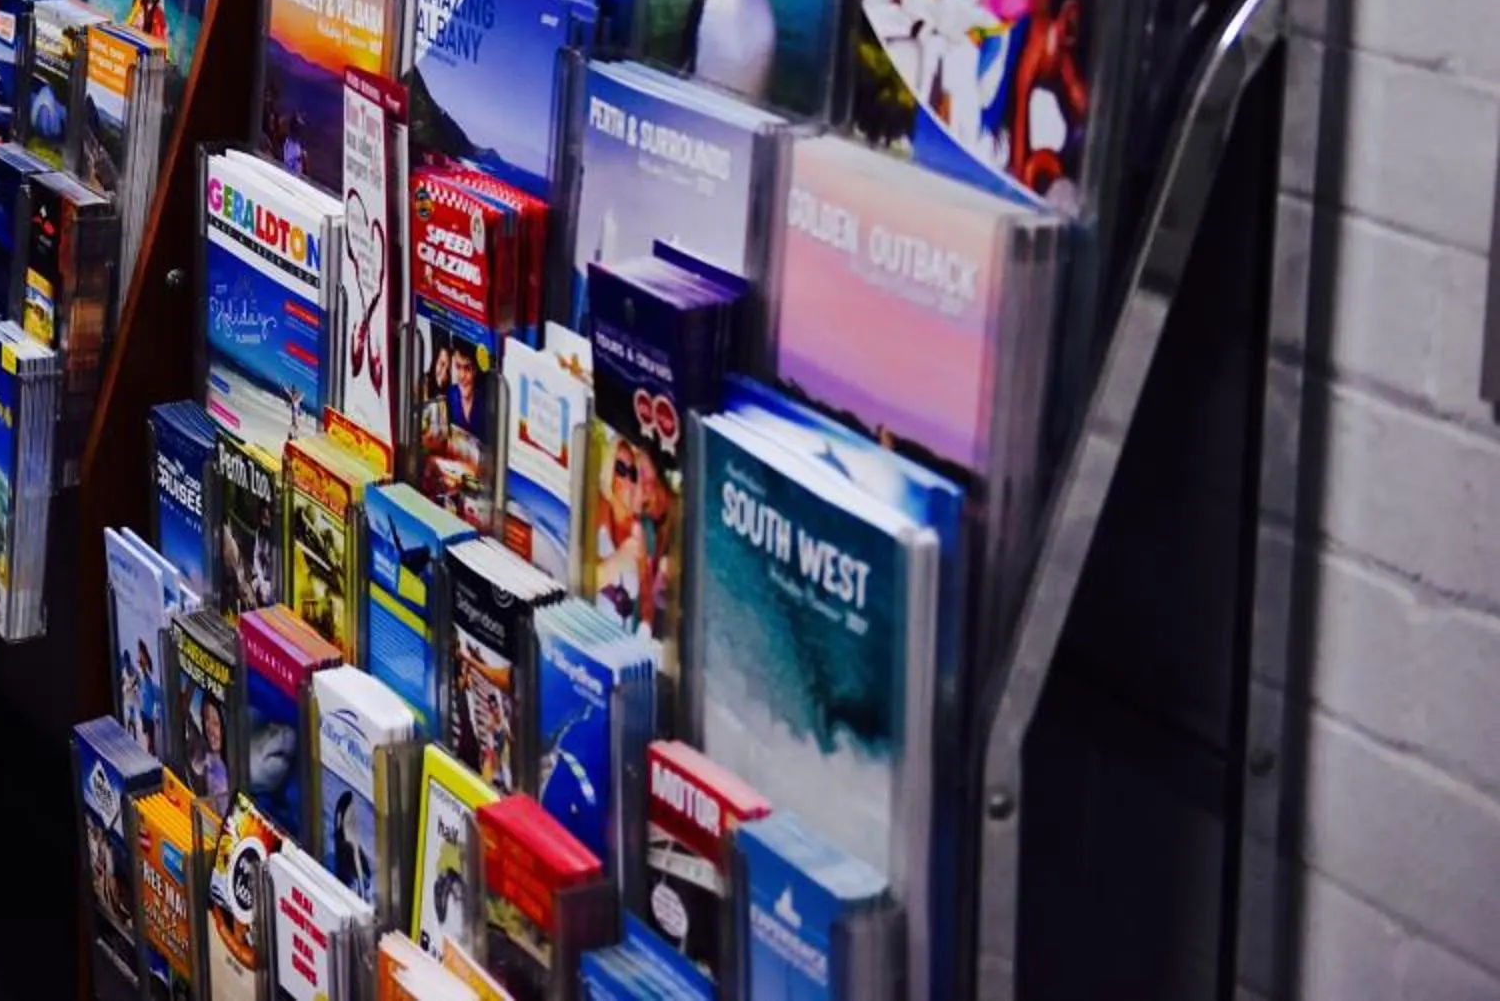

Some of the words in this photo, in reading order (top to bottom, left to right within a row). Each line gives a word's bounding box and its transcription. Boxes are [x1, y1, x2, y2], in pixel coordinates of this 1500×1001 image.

[416, 10, 484, 65] ALBANY
[590, 95, 626, 141] PERTH
[627, 114, 637, 148] &
[208, 177, 320, 272] GERALDTON
[722, 480, 792, 564] SOUTH
[798, 525, 871, 610] WEST
